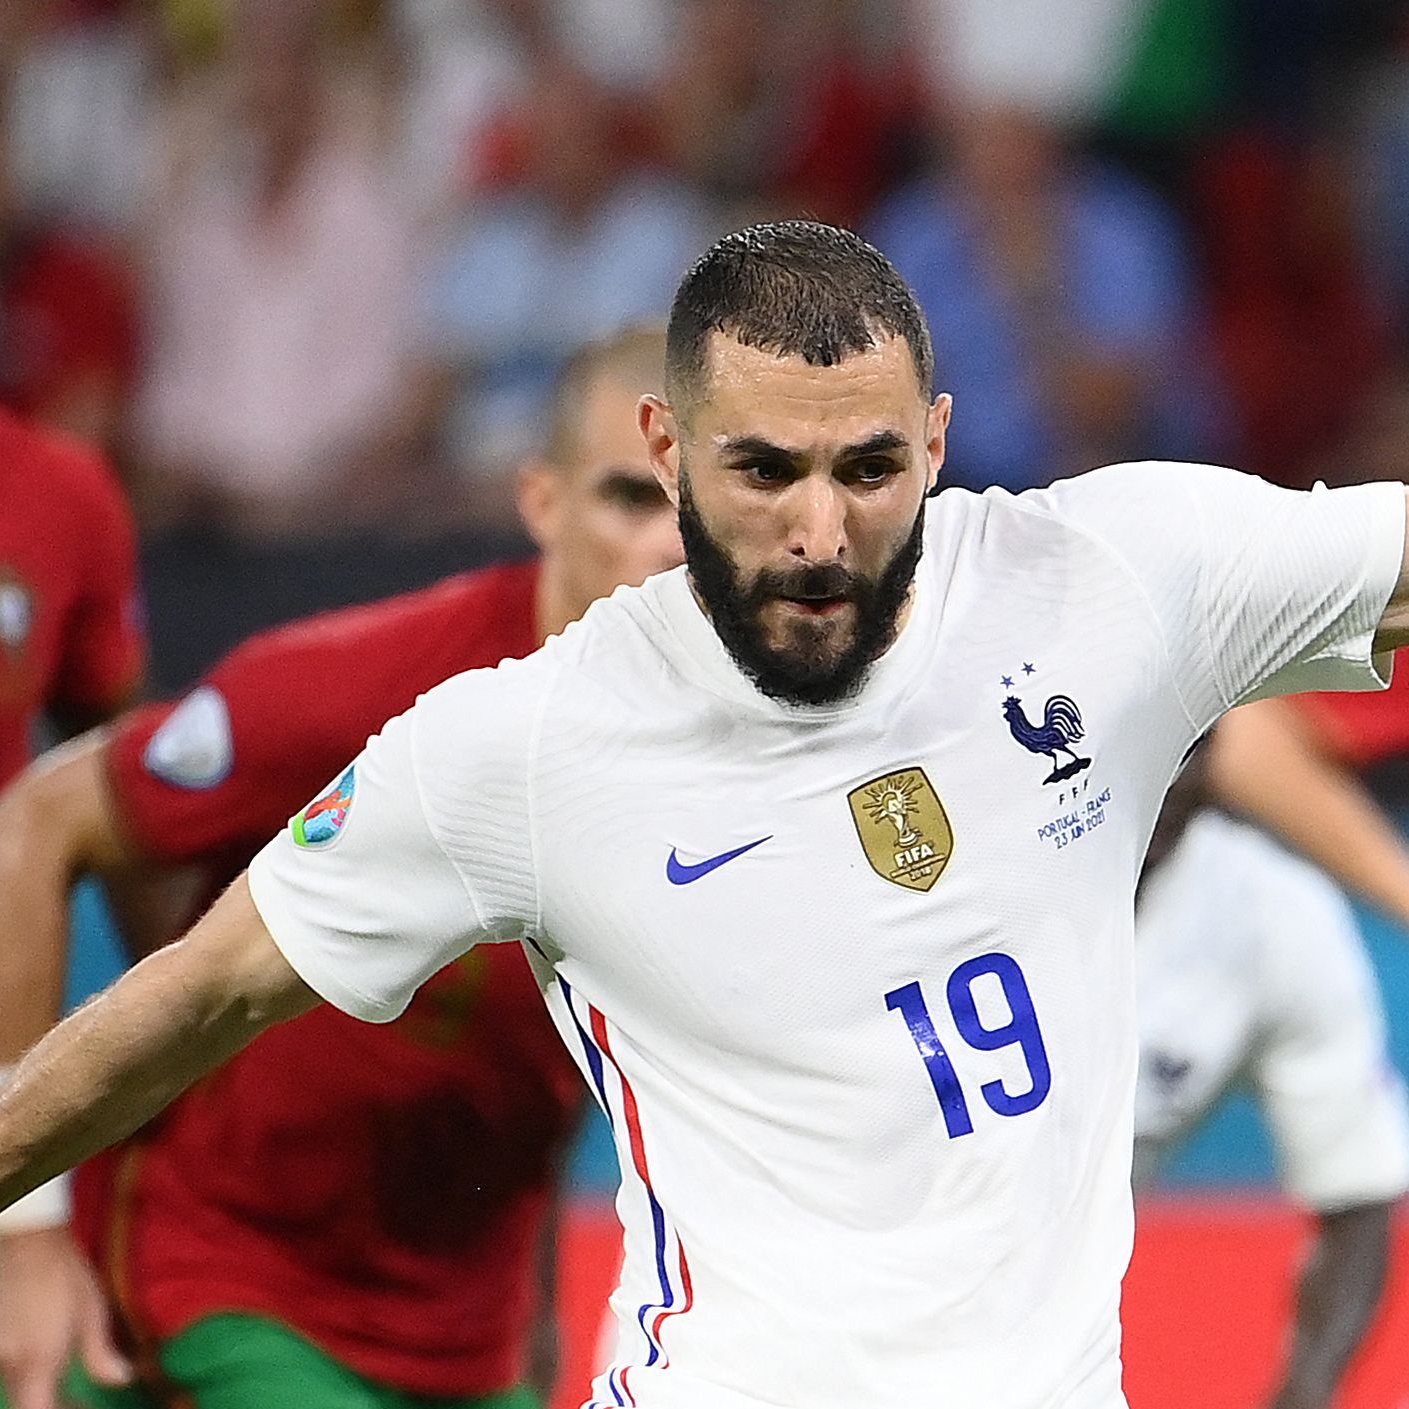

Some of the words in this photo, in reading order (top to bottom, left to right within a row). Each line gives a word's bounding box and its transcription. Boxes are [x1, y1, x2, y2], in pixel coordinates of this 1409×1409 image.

[1037, 810, 1080, 842] PORTUGAL
[1086, 787, 1112, 815] FRANCE
[1054, 832, 1068, 849] 23
[1071, 822, 1086, 842] JUN
[1085, 809, 1105, 832] 2021
[895, 843, 933, 867] FIFA
[884, 953, 1051, 1139] 19
